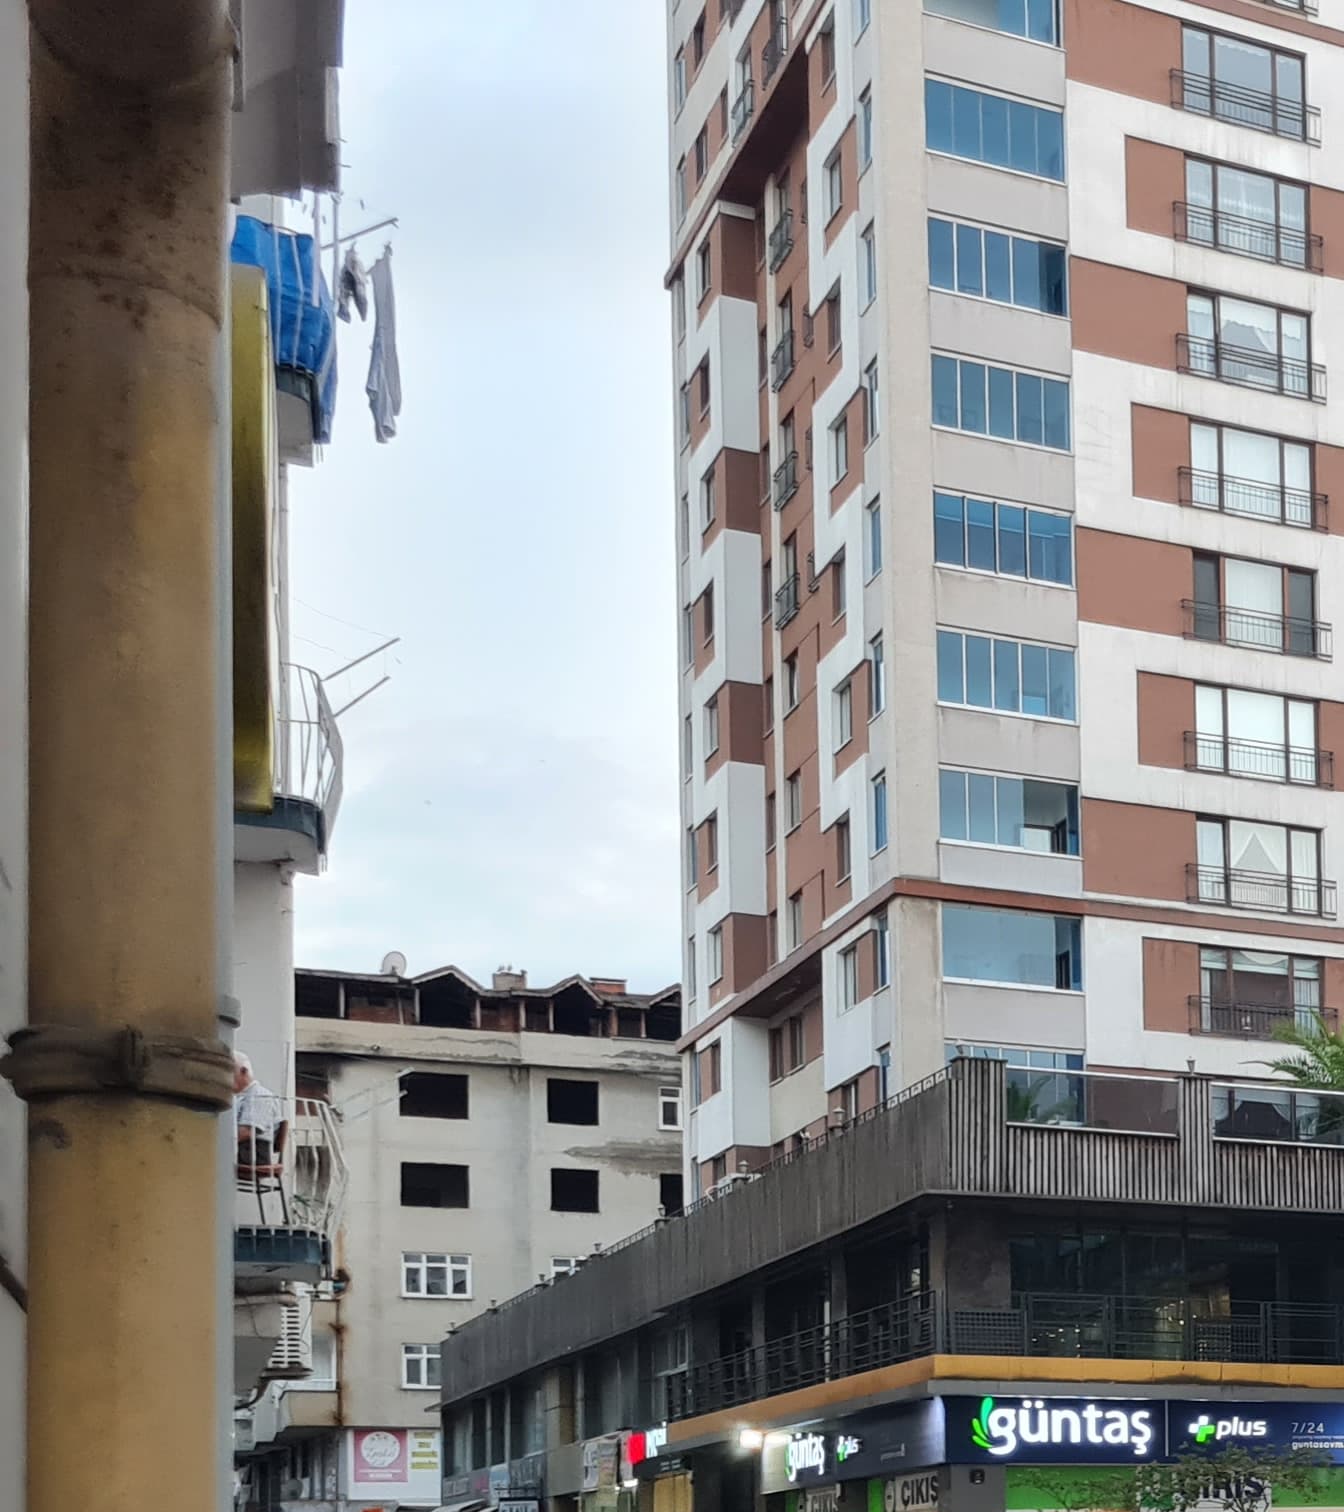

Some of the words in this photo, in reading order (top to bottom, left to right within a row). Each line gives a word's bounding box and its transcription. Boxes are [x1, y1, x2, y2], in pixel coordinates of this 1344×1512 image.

[986, 1402, 1152, 1455] güntaş
[1215, 1416, 1267, 1440] plus
[1291, 1422, 1324, 1434] 7/24
